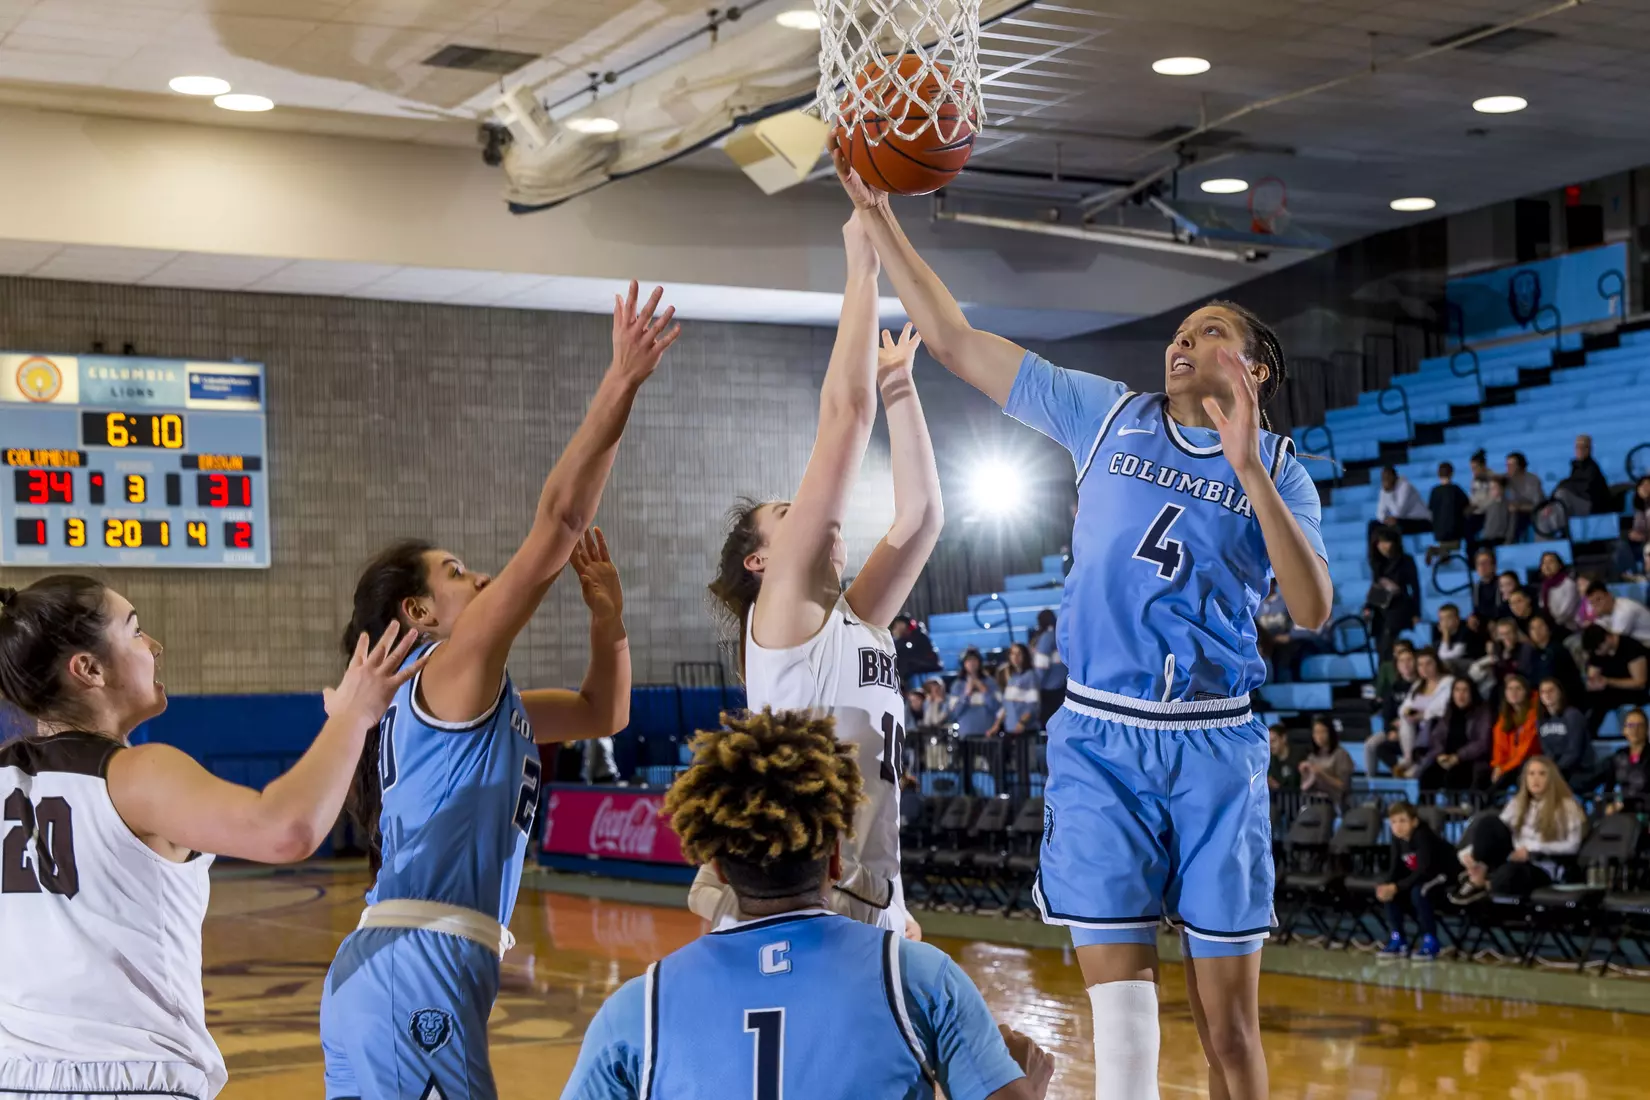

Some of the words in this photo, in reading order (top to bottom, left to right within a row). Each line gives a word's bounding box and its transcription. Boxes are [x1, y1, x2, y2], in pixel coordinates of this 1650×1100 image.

[88, 366, 176, 382] COLUMBIA
[110, 387, 155, 398] LIONS
[106, 412, 183, 448] 6:10
[28, 469, 73, 504] 34
[127, 474, 146, 503] 3
[209, 473, 251, 508] 31
[1109, 452, 1252, 518] COLUMBIA
[36, 519, 46, 545] 1
[67, 517, 86, 547] 3
[105, 518, 143, 547] 20
[160, 521, 169, 547] 1
[187, 521, 207, 547] 4
[233, 521, 252, 549] 2
[1132, 502, 1186, 581] 4
[2, 787, 80, 901] 20
[759, 940, 792, 976] C
[743, 1006, 786, 1100] 1
